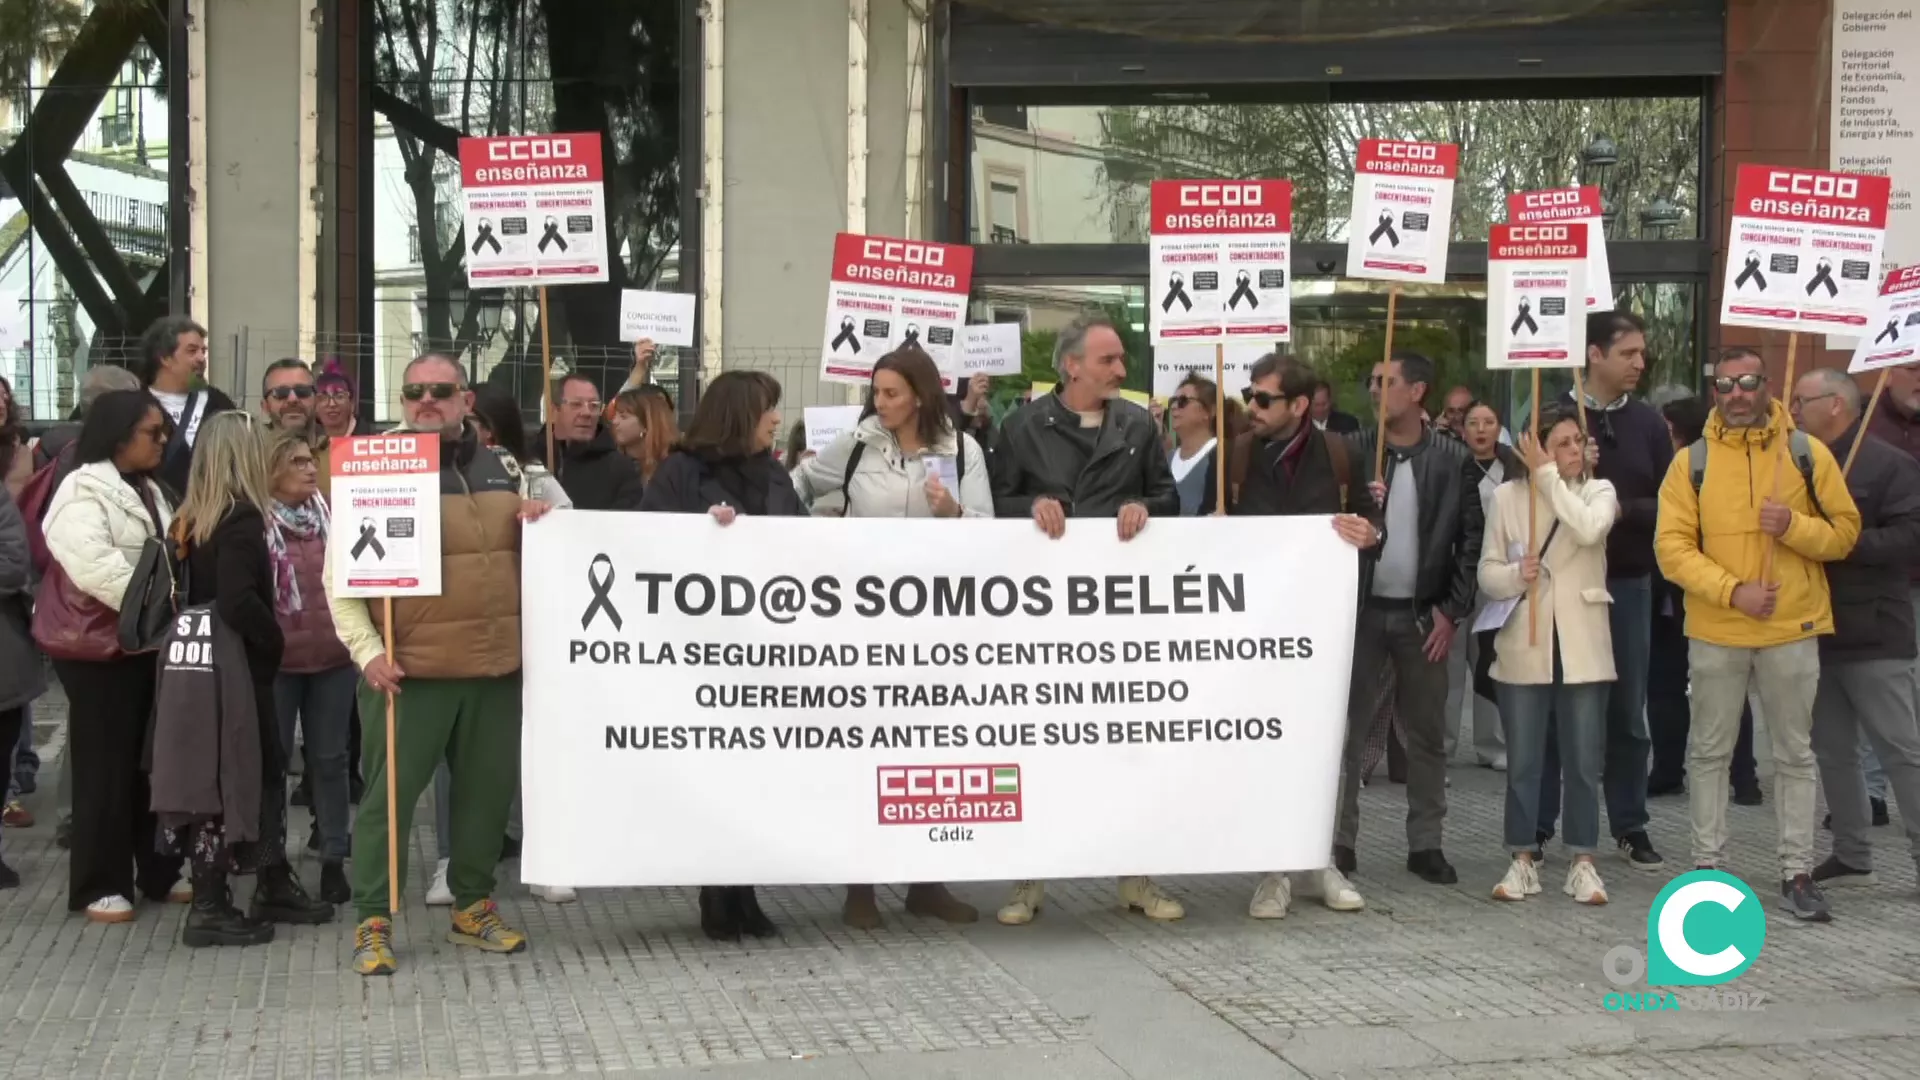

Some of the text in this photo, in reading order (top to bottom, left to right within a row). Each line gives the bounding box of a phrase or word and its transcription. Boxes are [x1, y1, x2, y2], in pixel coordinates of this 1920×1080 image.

[1842, 9, 1912, 21] Delegación del
[1842, 23, 1886, 32] Gobierno
[1841, 48, 1894, 60] Delegación
[1841, 60, 1890, 69] Territorial
[1841, 71, 1905, 82] de Economía,
[1841, 84, 1888, 93] Hacienda,
[1840, 95, 1875, 104] Fondos
[1840, 107, 1893, 117] Europeos y
[1840, 118, 1900, 128] de Industria,
[1840, 129, 1914, 140] Energía y Minas
[488, 139, 572, 161] CCOO
[1378, 143, 1436, 160] CCOO
[1366, 160, 1445, 175] enseñanza
[1839, 156, 1892, 166] Delegación
[475, 163, 588, 182] enseñanza
[1768, 171, 1858, 199] CCOO
[1180, 184, 1262, 207] CCOO
[1525, 191, 1579, 208] CCOO
[1518, 205, 1591, 221] enseñanza
[1750, 197, 1871, 222] enseñanza
[1166, 209, 1276, 228] enseñanza
[1509, 226, 1568, 241] CCOO
[863, 239, 944, 266] CCOO
[1499, 244, 1577, 257] enseñanza
[846, 263, 955, 288] enseñanza
[1900, 267, 1920, 280] CC
[981, 334, 989, 342] AL
[964, 359, 1004, 369] SOLITARIO
[1158, 363, 1169, 371] YO
[1222, 363, 1235, 371] OY
[353, 437, 416, 456] CCOO
[342, 457, 428, 472] enseñanza
[635, 564, 1246, 624] TOD@S SOMOS BELÉN
[569, 636, 1313, 667] POR LA SEGURIDAD EN LOS CENTROS DE MENORES
[695, 679, 1189, 708] QUEREMOS TRABAJAR SIN MIEDO
[605, 717, 1283, 750] NUESTRAS VIDAS ANTES QUE SUS BENEFICIOS
[879, 768, 989, 796] CCOO
[883, 797, 1016, 820] enseñanza
[928, 826, 974, 842] Cádiz
